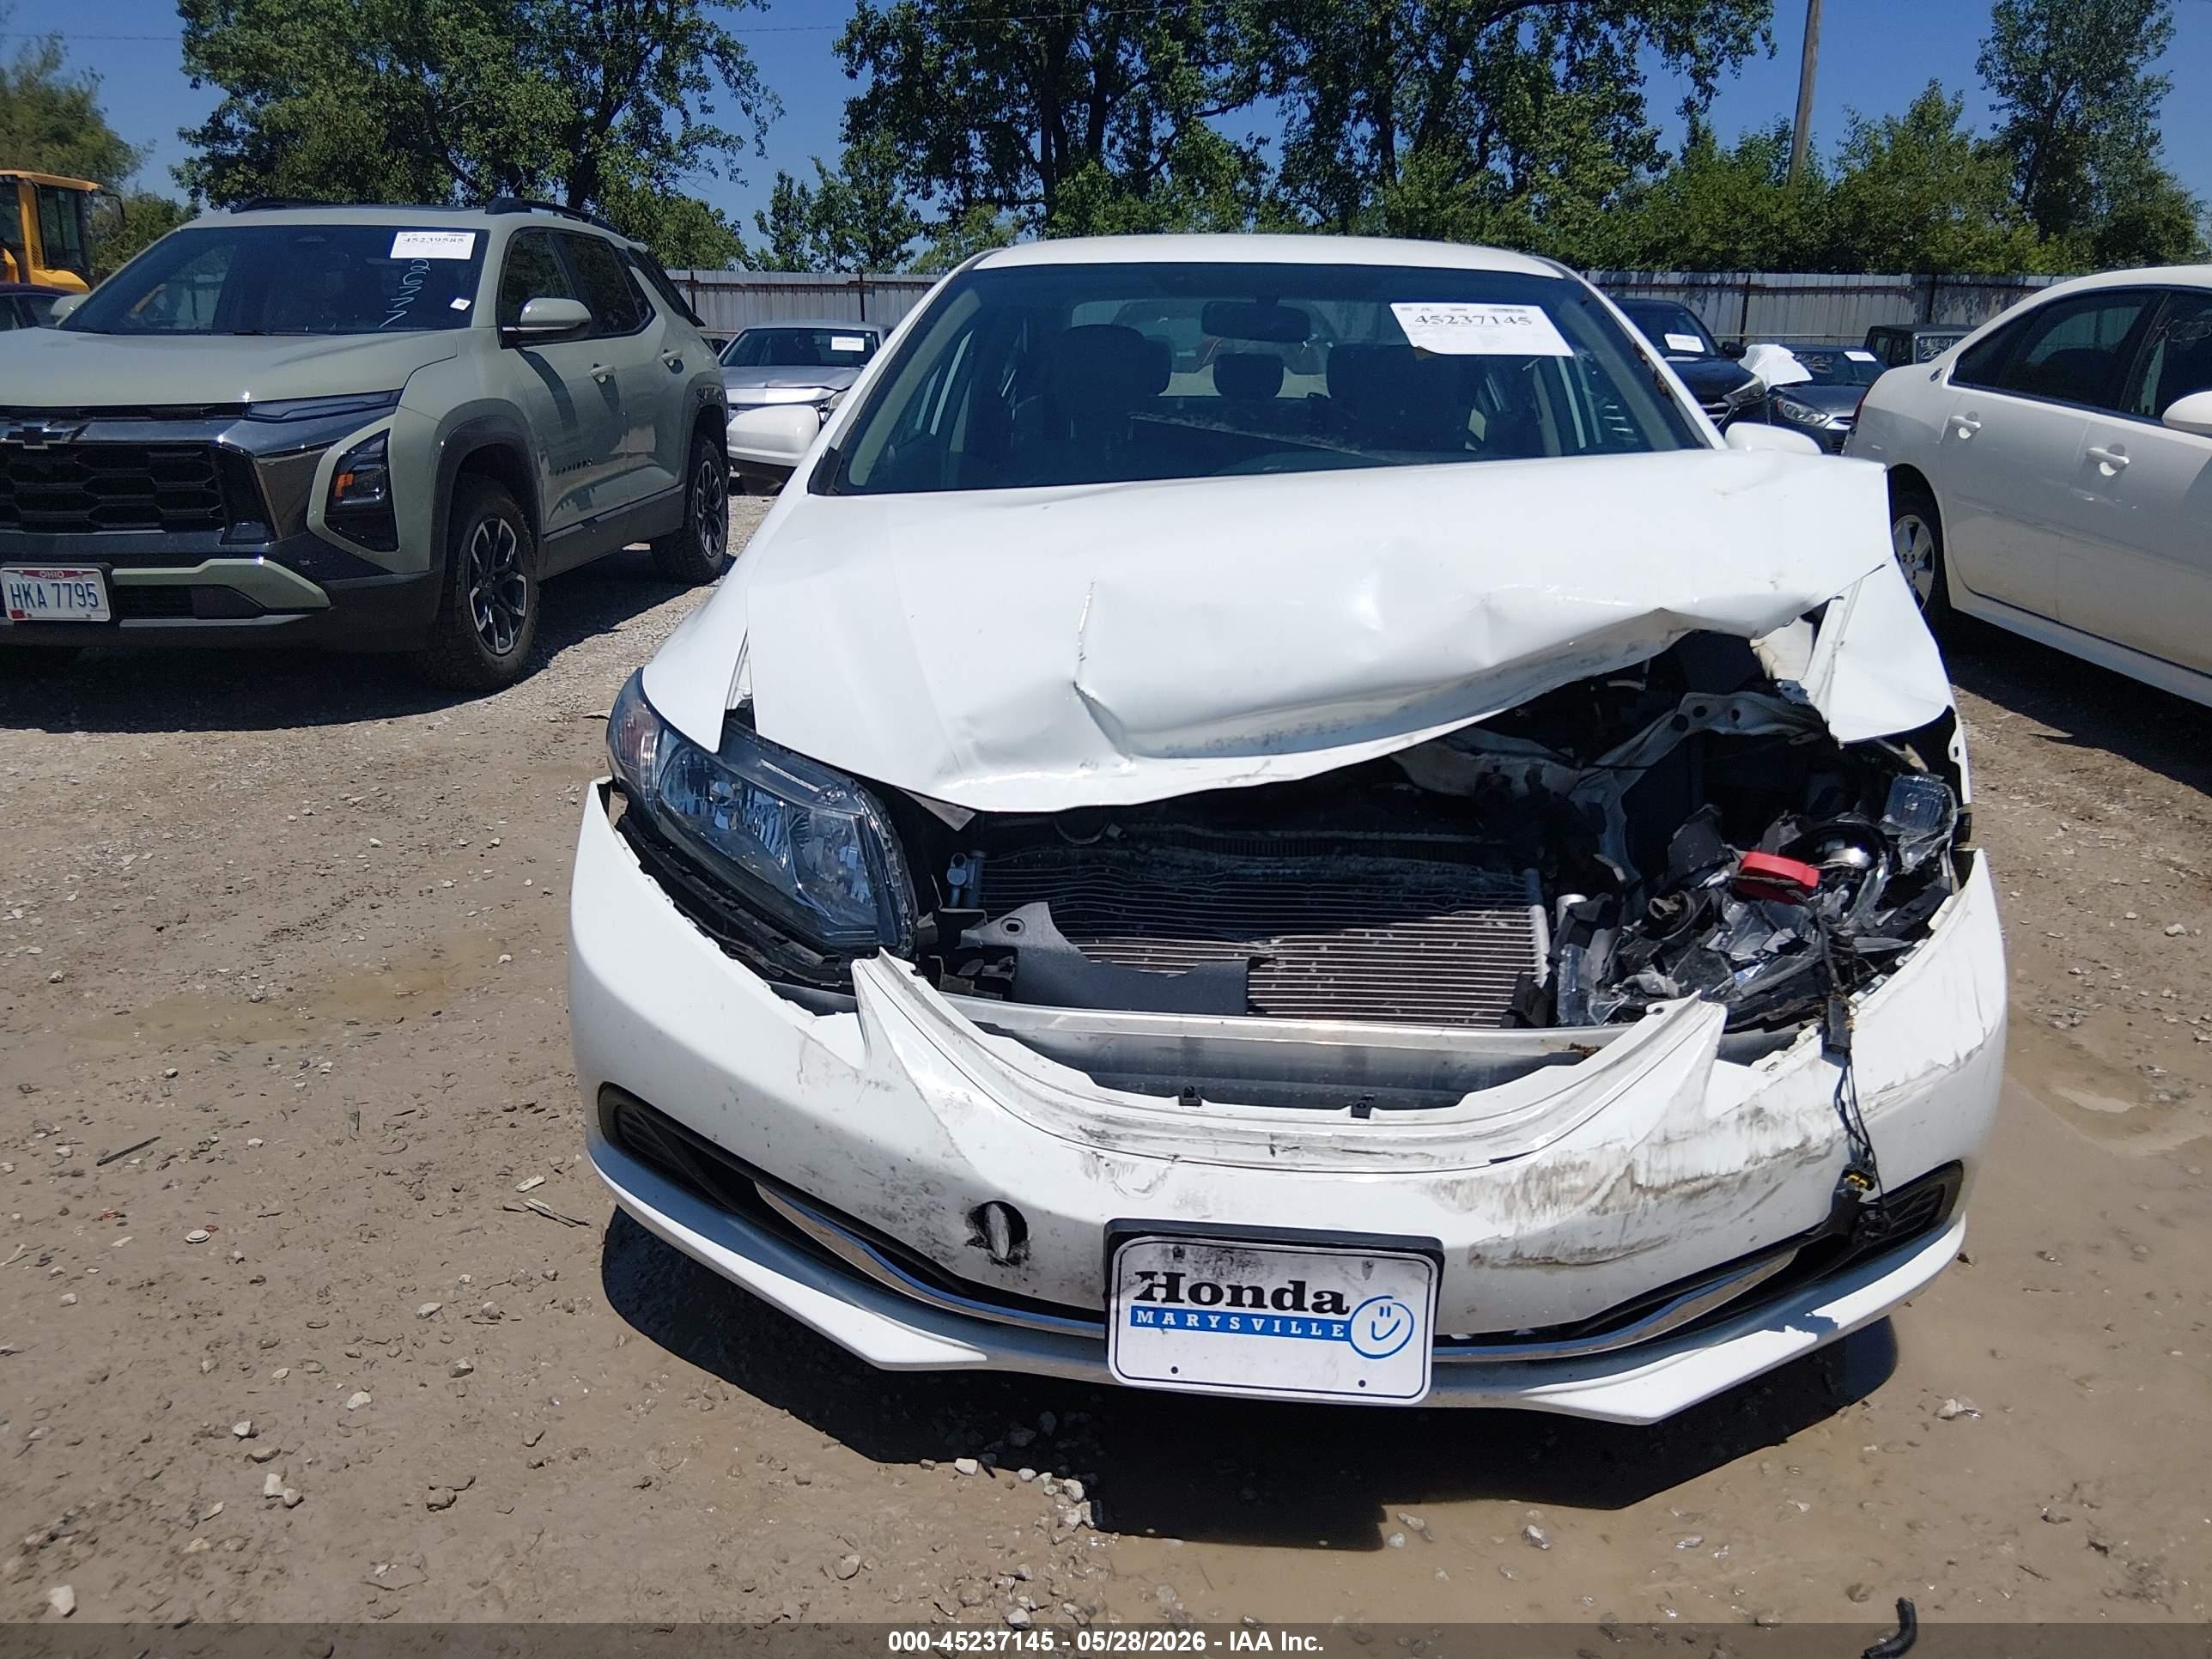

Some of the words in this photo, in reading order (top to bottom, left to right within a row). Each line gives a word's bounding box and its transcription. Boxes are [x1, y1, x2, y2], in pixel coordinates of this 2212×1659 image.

[1414, 314, 1533, 326] 45237145
[40, 570, 64, 579] OHIO
[9, 582, 47, 608] HKA
[51, 582, 98, 608] 7795
[1133, 1271, 1350, 1316] Honda
[1136, 1310, 1345, 1338] MARYSVILLE
